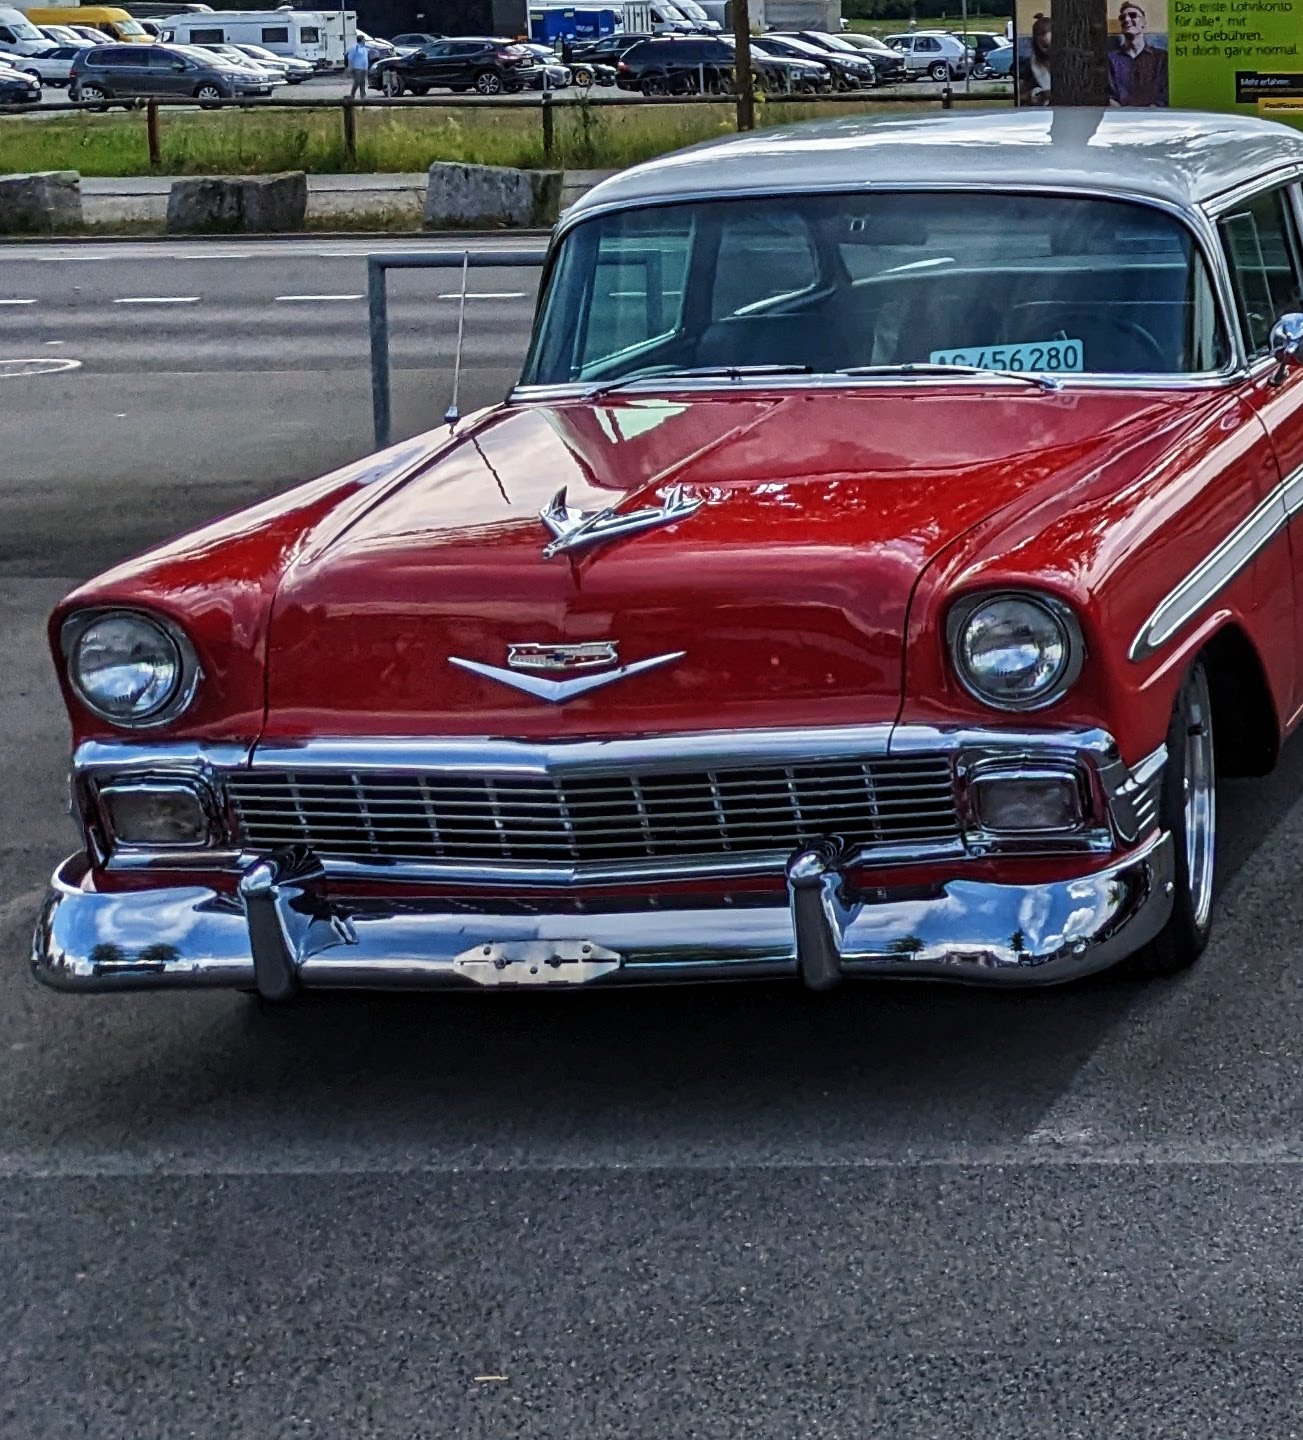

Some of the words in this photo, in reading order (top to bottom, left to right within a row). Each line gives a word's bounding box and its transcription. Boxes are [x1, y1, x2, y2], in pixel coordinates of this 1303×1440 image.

[1175, 1, 1194, 12] Das
[1230, 0, 1293, 12] Lohnkonto
[1174, 15, 1191, 27] für
[1227, 16, 1246, 27] mit
[1192, 44, 1220, 57] doch
[1224, 46, 1252, 59] ganz
